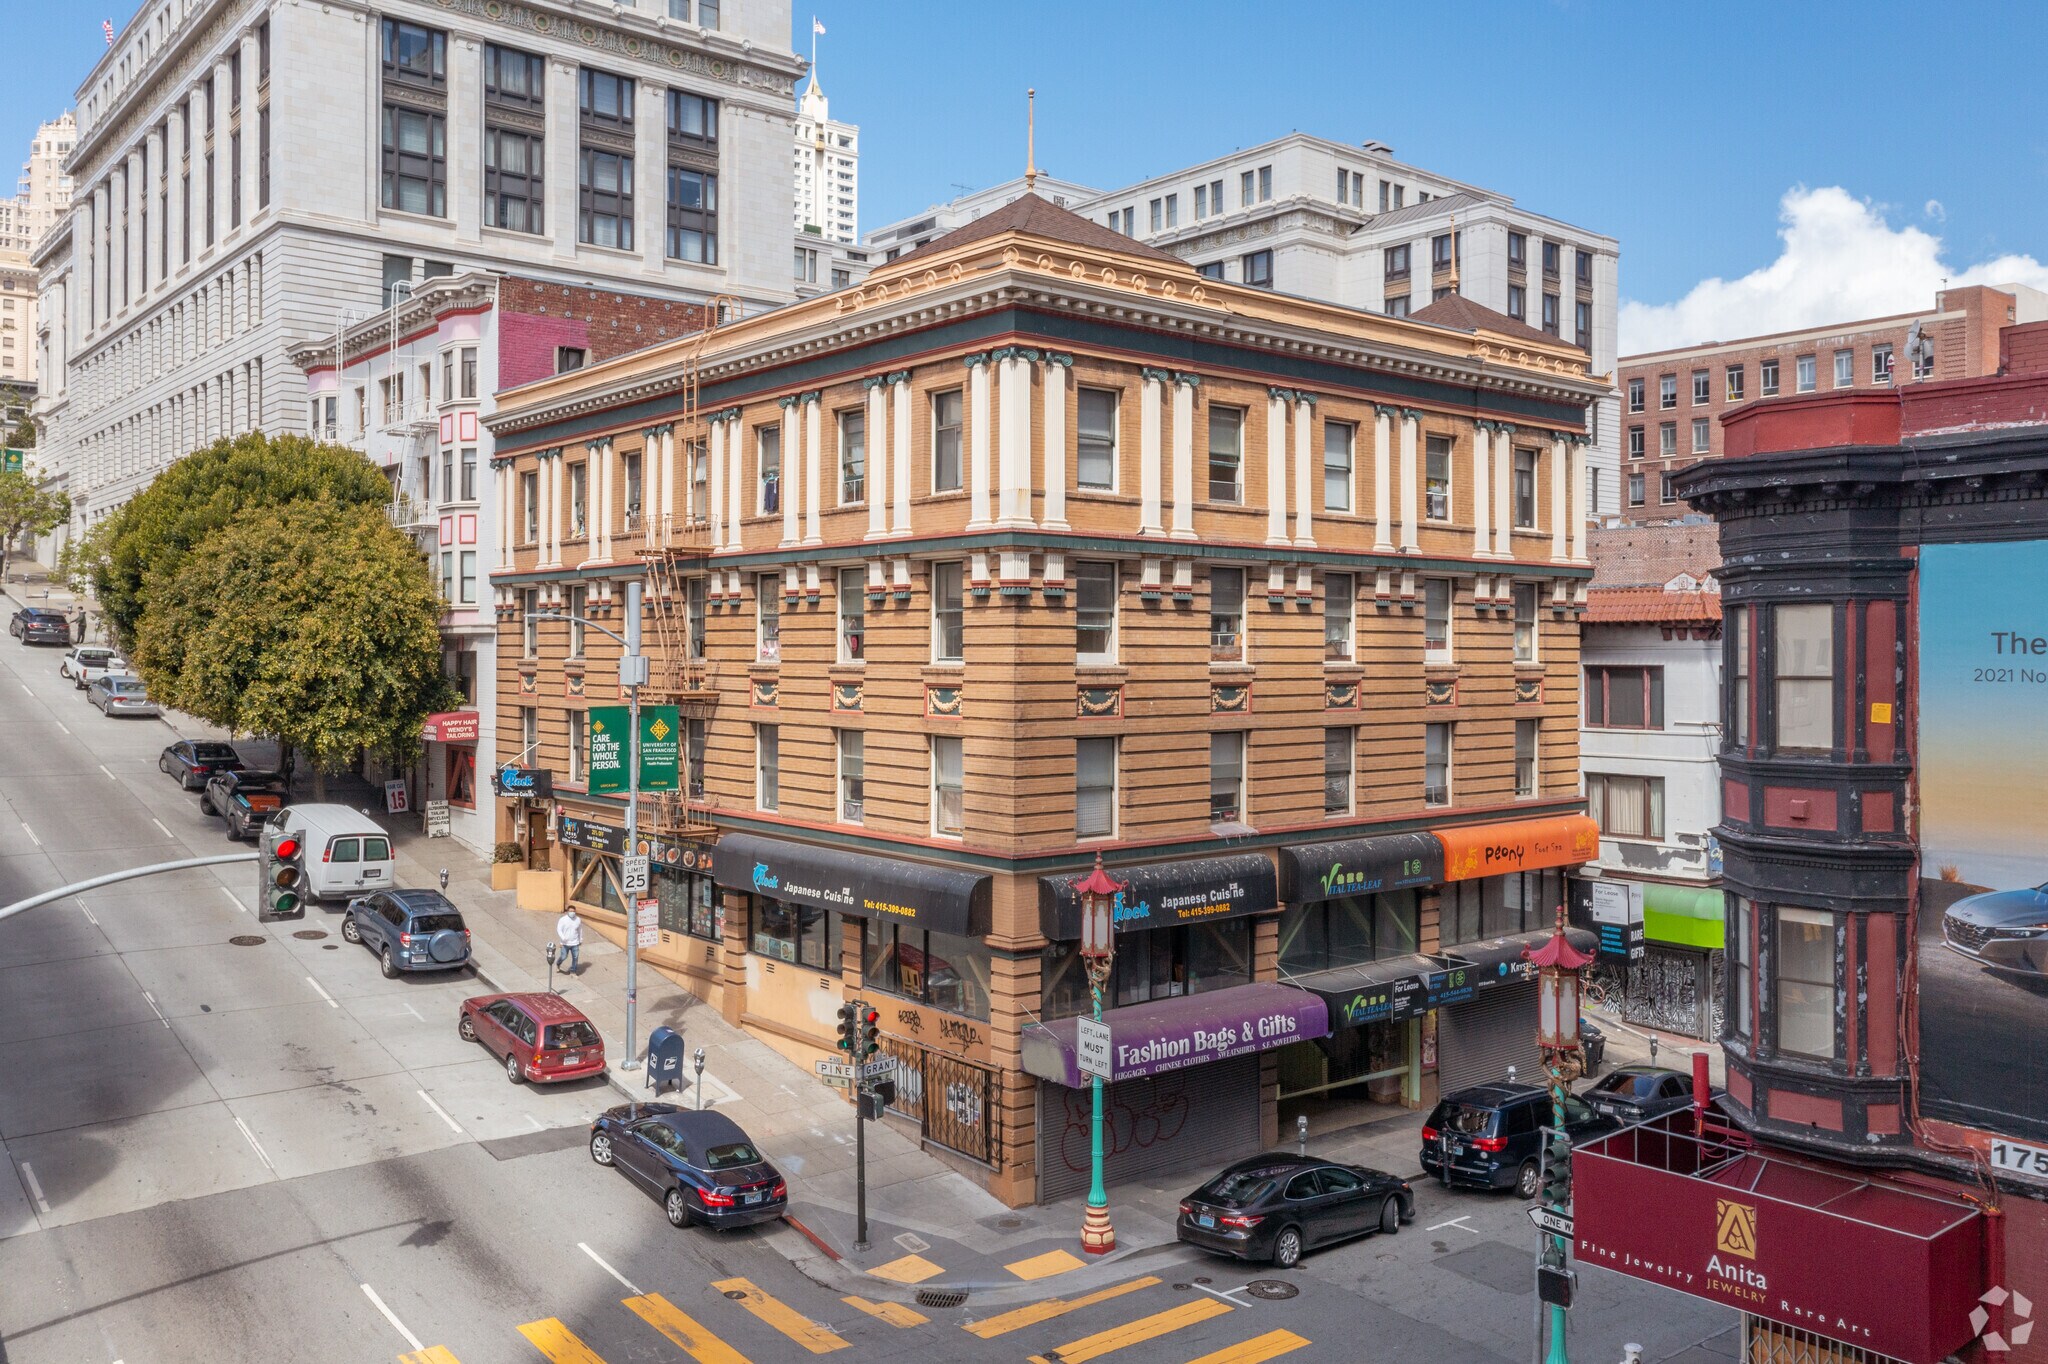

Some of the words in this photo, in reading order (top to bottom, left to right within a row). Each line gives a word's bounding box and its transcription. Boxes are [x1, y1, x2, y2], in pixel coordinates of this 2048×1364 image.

[1991, 632, 2048, 655] The
[1974, 668, 2014, 682] 2021
[592, 734, 610, 743] CARE
[592, 743, 606, 752] FOR
[607, 742, 620, 751] THE
[592, 751, 617, 761] WHOLE
[592, 760, 620, 770] PERSON.
[504, 771, 534, 789] Rock
[625, 874, 646, 888] 25
[1347, 879, 1382, 892] TEA-LEAF
[784, 882, 821, 898] Japanese
[824, 887, 854, 905] Cuisine
[863, 899, 875, 909] Tel:
[875, 901, 916, 917] 415-399-0882
[1114, 899, 1150, 922] Rock
[1161, 893, 1207, 909] Japanese
[1210, 883, 1245, 902] Cuisine
[1178, 909, 1190, 918] Tel:
[1190, 903, 1231, 916] 415-399-0882
[1630, 929, 1643, 942] RARE
[1630, 946, 1645, 959] GIFTS
[1394, 984, 1404, 993] For
[1404, 982, 1419, 992] Lease
[1367, 1002, 1392, 1014] TEA-LEA
[1080, 1026, 1093, 1036] LEFT
[1096, 1030, 1109, 1041] LANE
[1084, 1041, 1104, 1054] MUST
[1118, 1038, 1190, 1067] Fashion
[1194, 1027, 1237, 1051] Bags
[1241, 1021, 1254, 1042] &
[1258, 1015, 1296, 1038] Gifts
[1080, 1053, 1093, 1065] TURN
[1095, 1059, 1107, 1070] LEFT
[1114, 1067, 1147, 1081] LUGGAGES
[1155, 1061, 1182, 1072] CHINESE
[1183, 1054, 1210, 1067] CLOTHES
[1218, 1045, 1256, 1059] SWEATSHIRTS
[1272, 1035, 1301, 1047] NOVELTIES
[821, 1064, 851, 1076] PINE
[866, 1059, 895, 1074] GRANT
[1543, 1215, 1562, 1229] ONE
[1581, 1240, 1616, 1259] Fine
[1625, 1253, 1693, 1283] Jewelry
[1706, 1254, 1767, 1289] Anita
[1706, 1278, 1767, 1304] JEWELRY
[1781, 1300, 1826, 1322] Rare
[1837, 1318, 1870, 1337] Art
